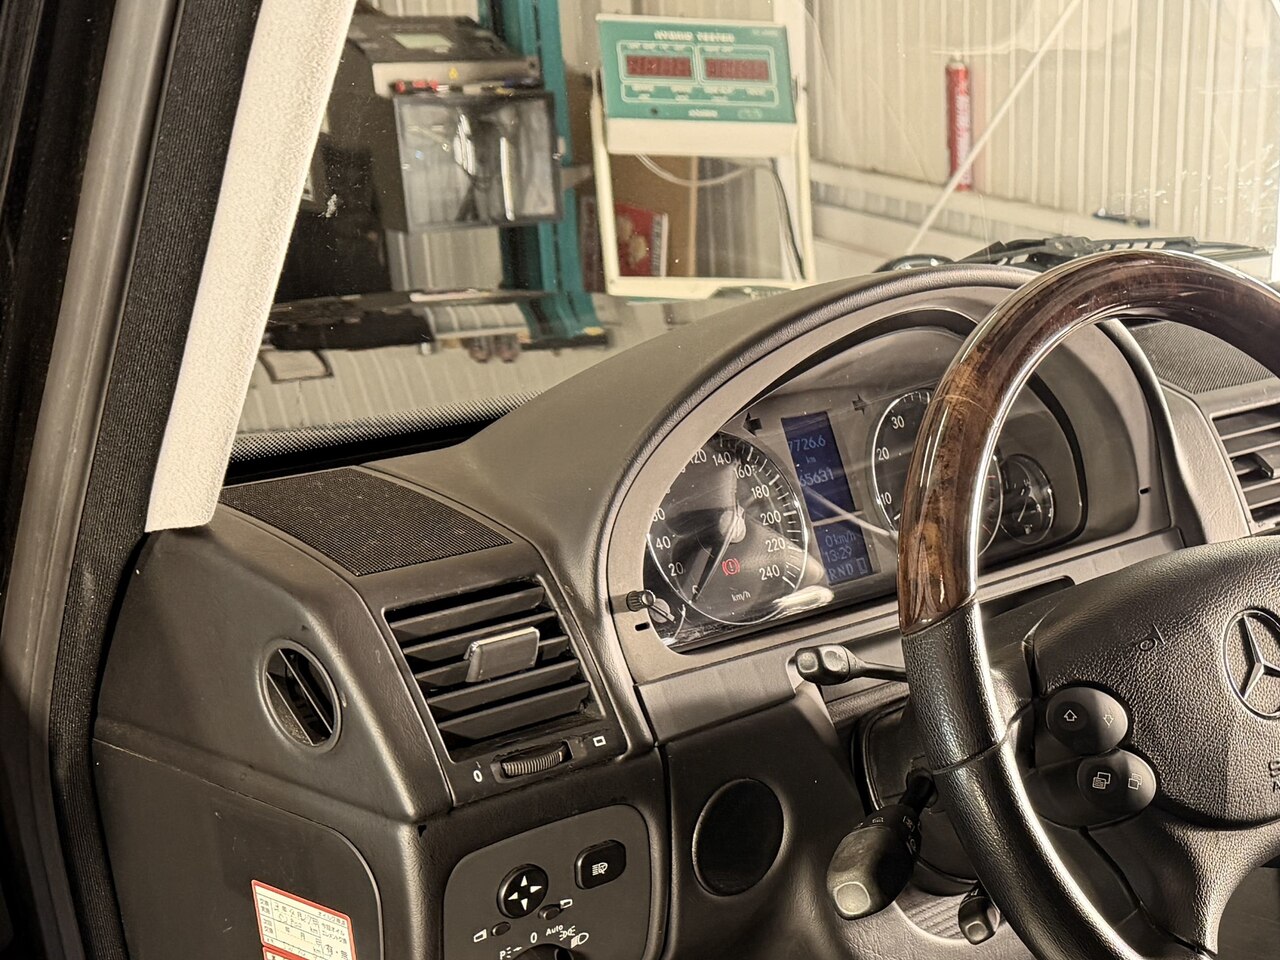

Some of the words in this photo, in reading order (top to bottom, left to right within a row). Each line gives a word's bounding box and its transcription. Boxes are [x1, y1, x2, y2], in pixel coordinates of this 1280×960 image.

[891, 415, 905, 430] 30
[712, 453, 732, 467] 140
[876, 446, 890, 461] 20
[734, 465, 751, 480] 160
[750, 484, 770, 499] 180
[880, 491, 892, 505] 10
[760, 510, 782, 526] 200
[655, 536, 671, 550] 40
[765, 537, 786, 553] 220
[825, 545, 852, 563] 13:29
[668, 562, 683, 577] 20
[759, 564, 780, 581] 240
[731, 590, 751, 602] km/h
[530, 931, 537, 943] 0
[546, 924, 563, 936] Auto
